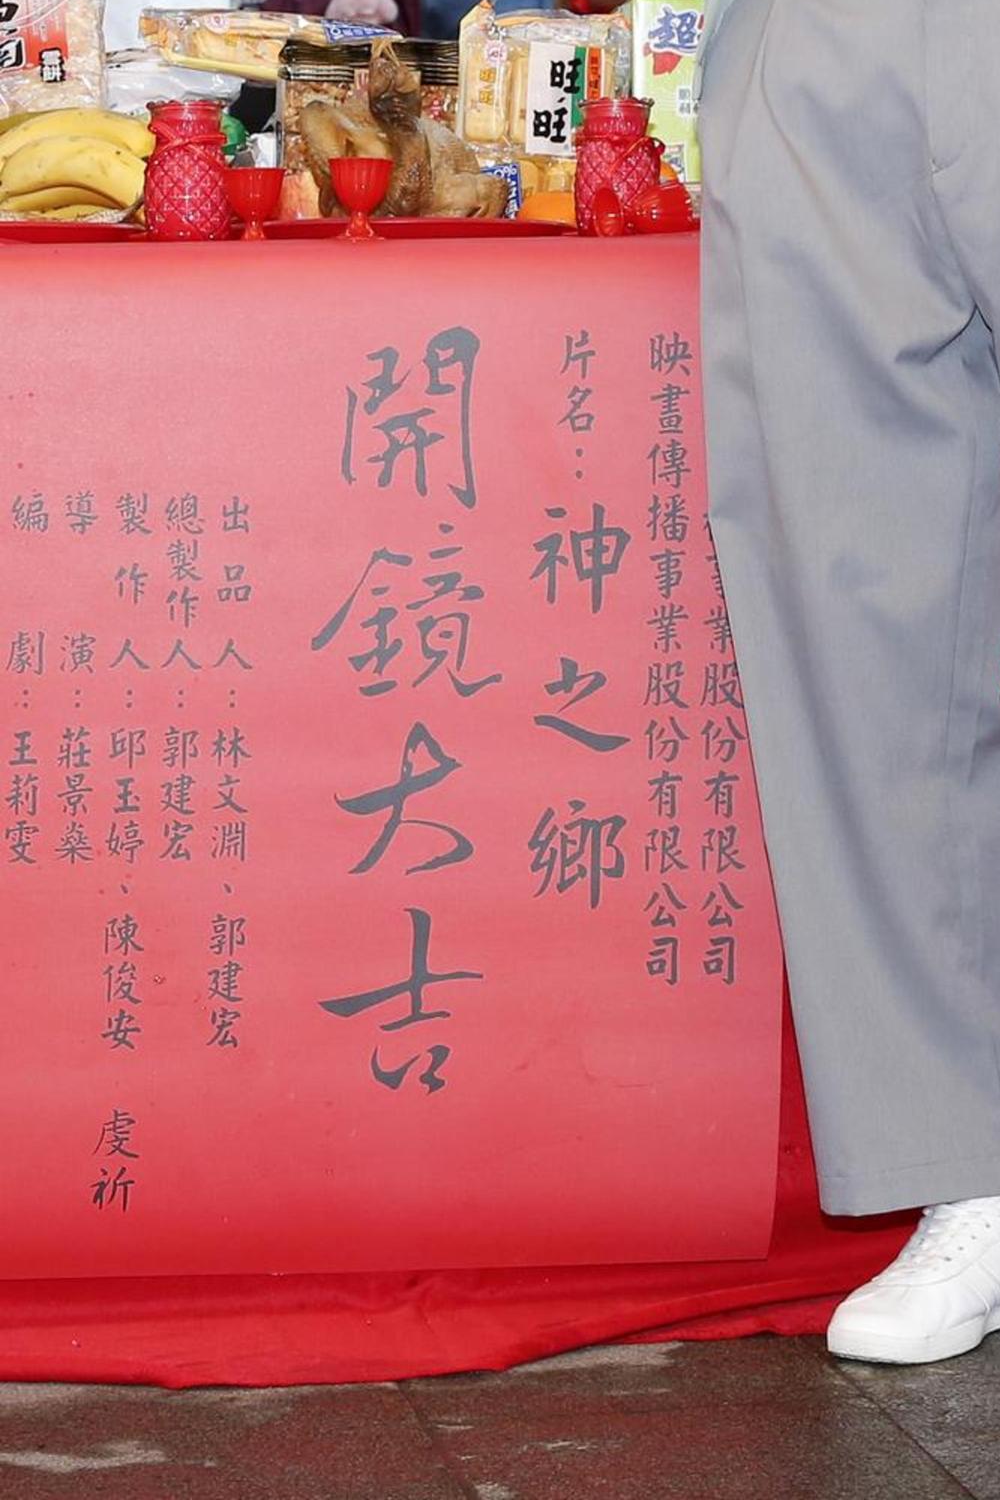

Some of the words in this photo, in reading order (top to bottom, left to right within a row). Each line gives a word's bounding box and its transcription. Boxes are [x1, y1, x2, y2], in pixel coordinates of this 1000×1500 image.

[648, 8, 704, 54] 超
[310, 325, 502, 1096] 開鏡大吉
